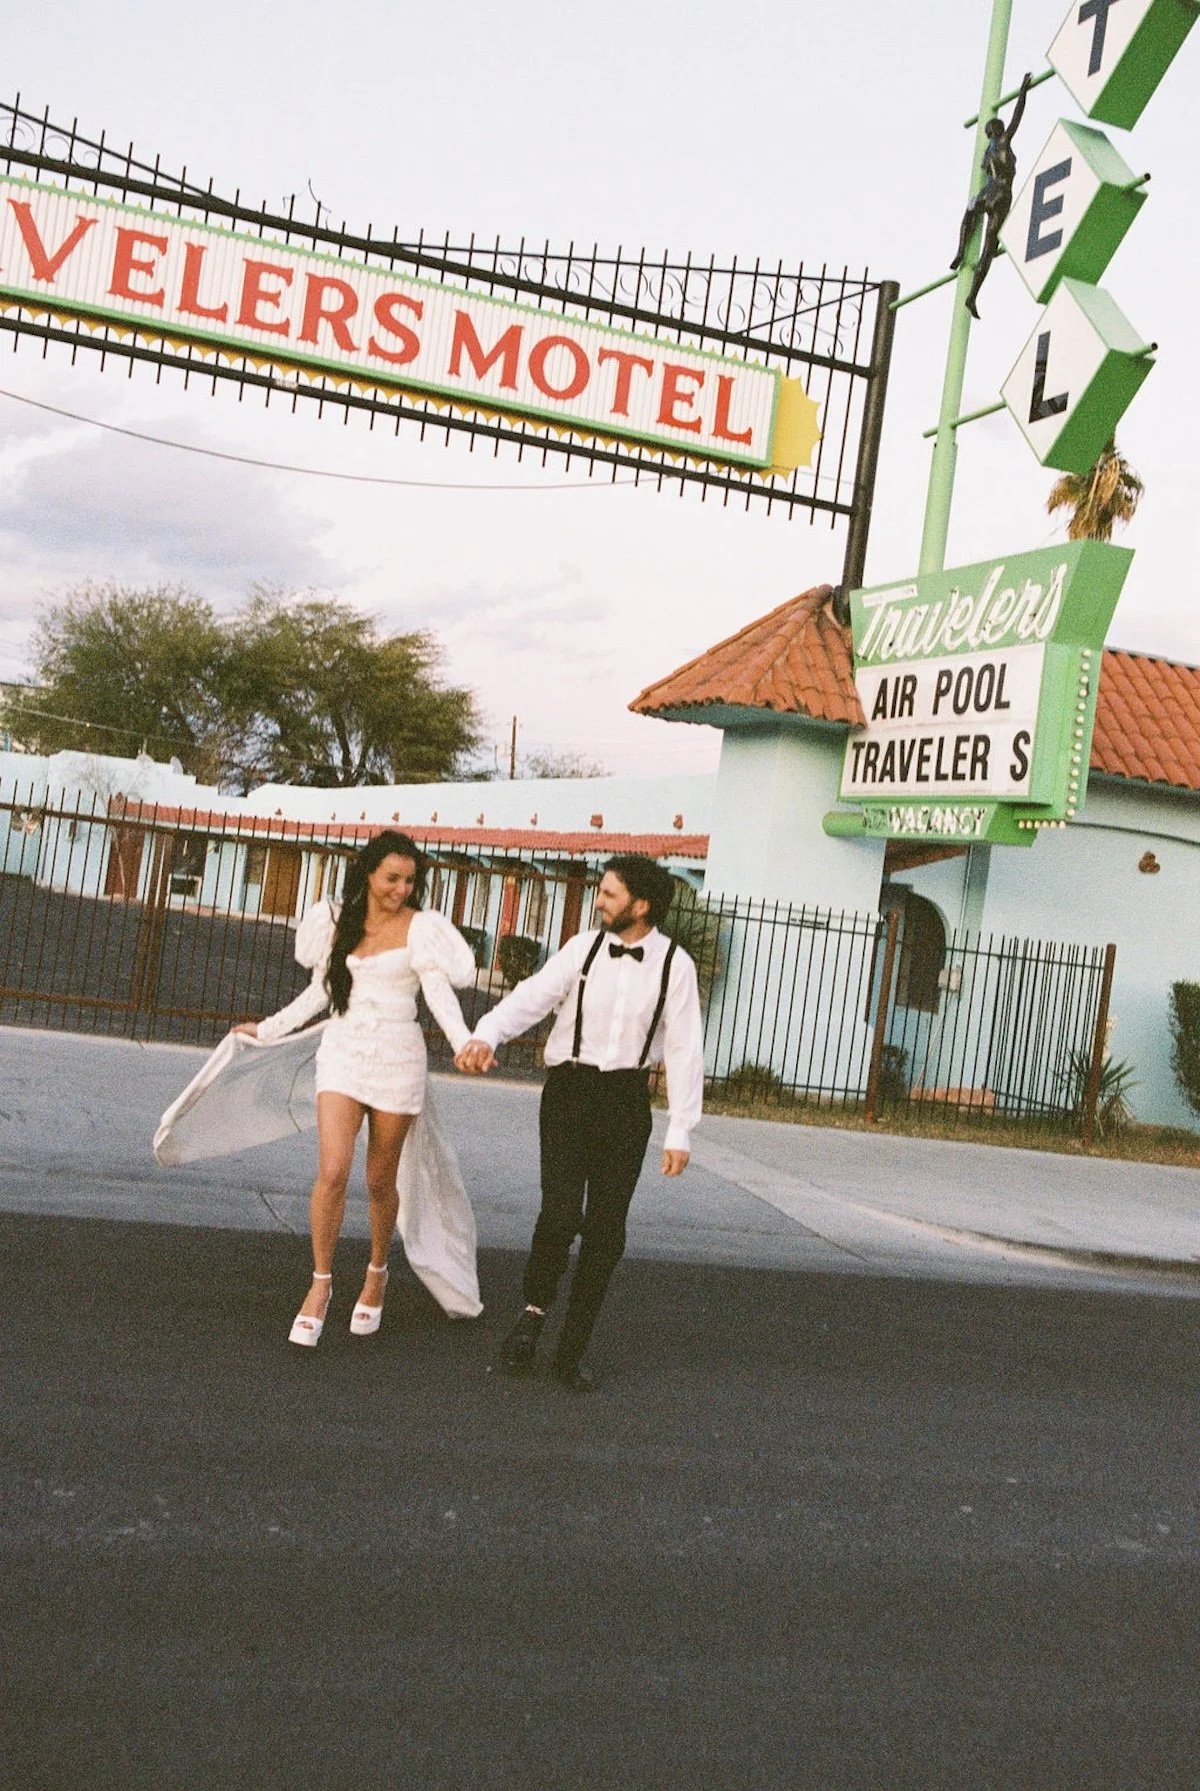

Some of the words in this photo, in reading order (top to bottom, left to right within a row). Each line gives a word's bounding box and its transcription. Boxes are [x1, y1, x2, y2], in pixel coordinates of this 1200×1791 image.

[0, 198, 424, 365] VELERS
[447, 309, 753, 447] MOTEL
[856, 563, 1067, 661] Travelers
[872, 674, 918, 721] AIR
[932, 663, 1011, 716] POOL
[851, 734, 991, 783] TRAVELER
[889, 806, 988, 836] VACANCY
